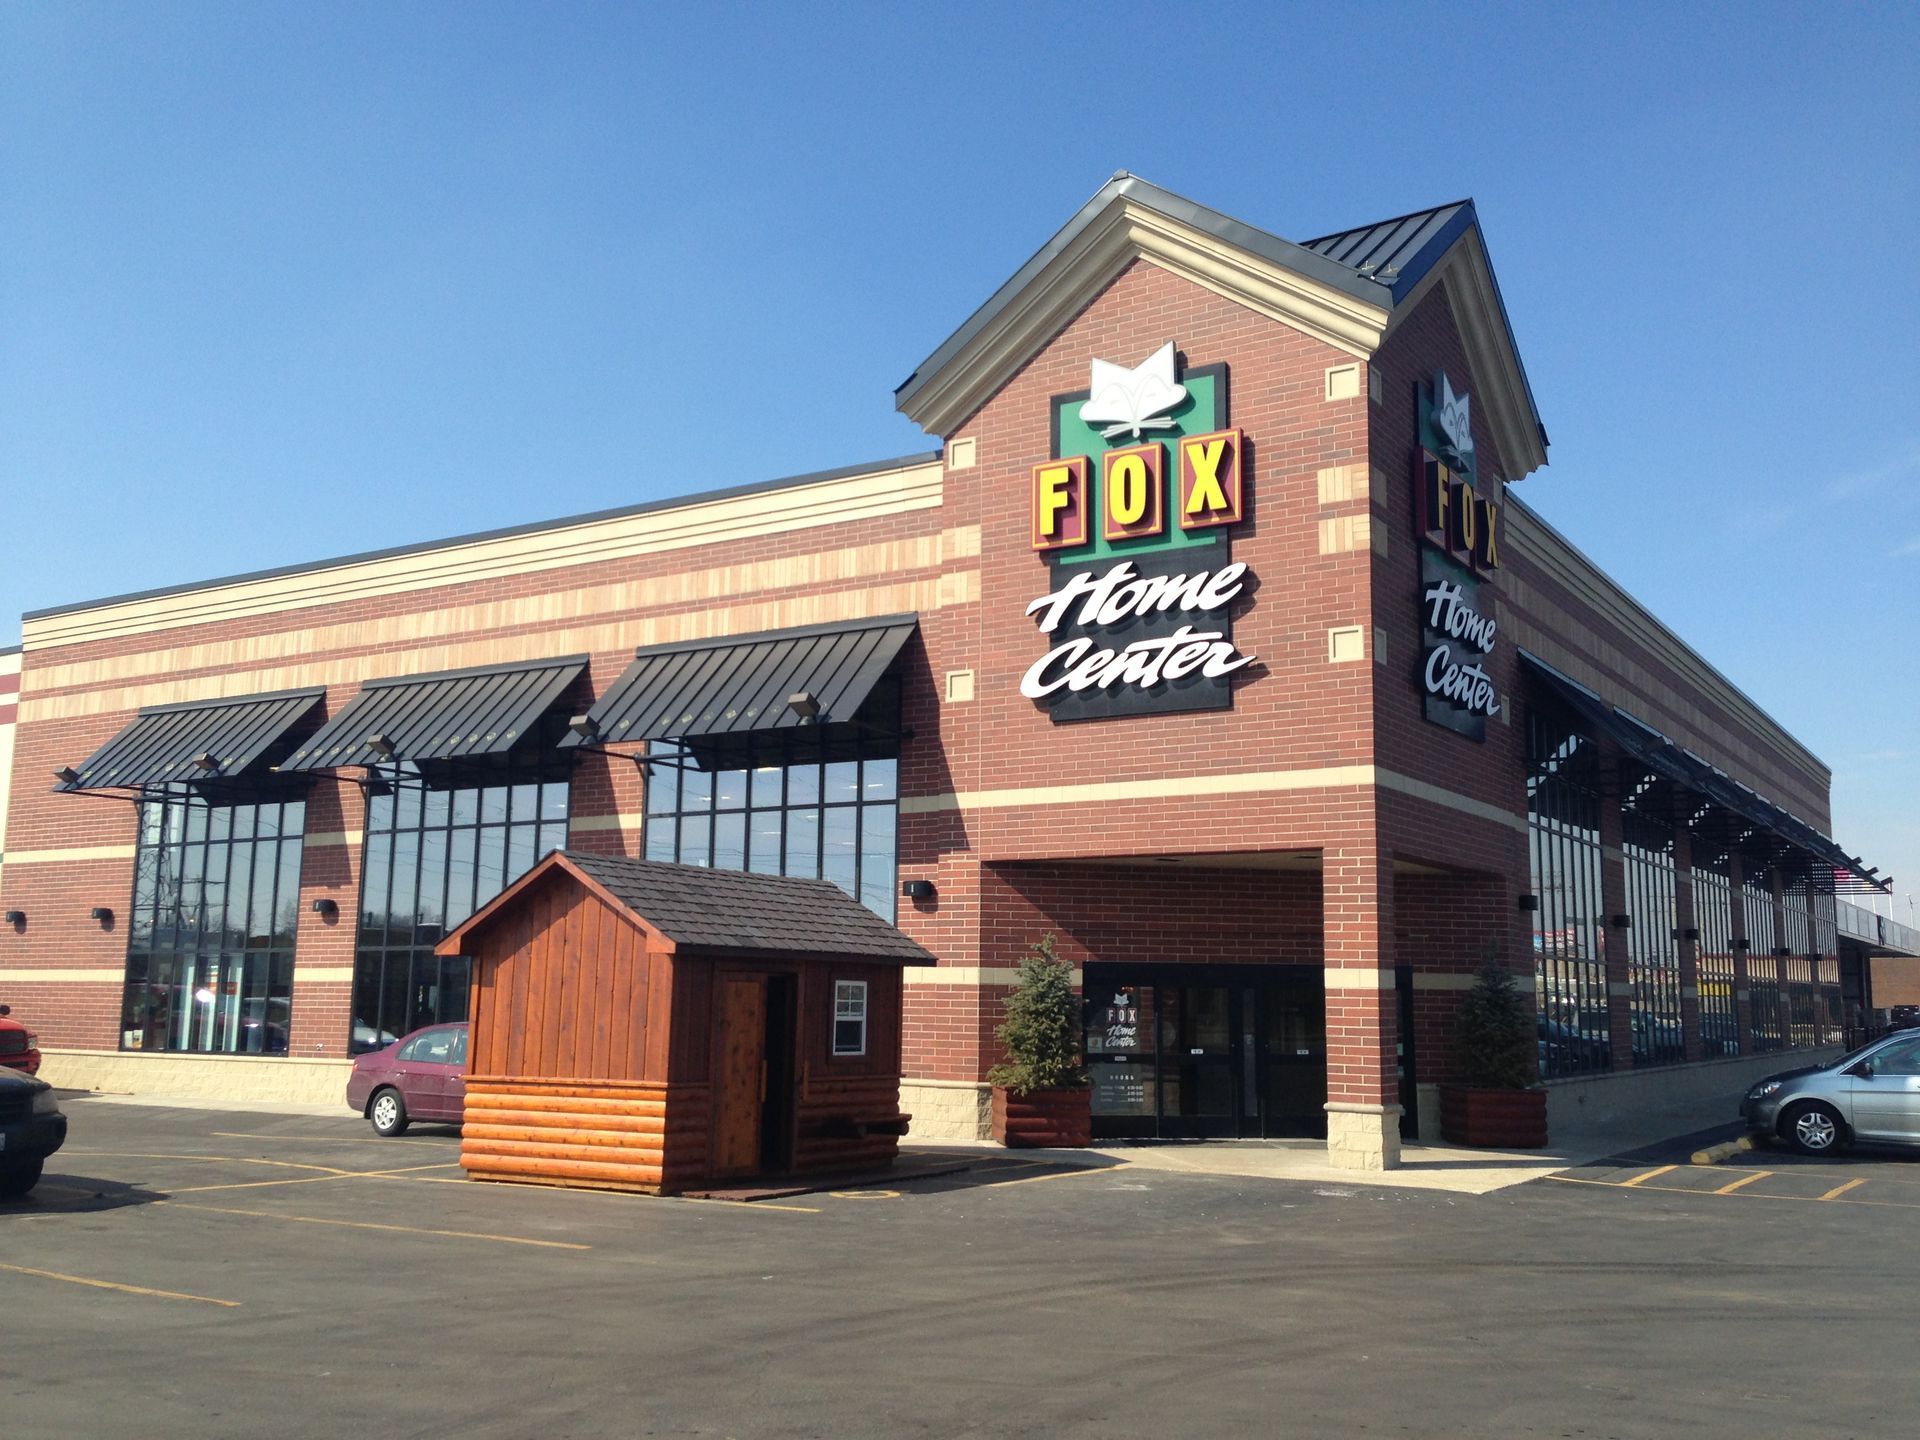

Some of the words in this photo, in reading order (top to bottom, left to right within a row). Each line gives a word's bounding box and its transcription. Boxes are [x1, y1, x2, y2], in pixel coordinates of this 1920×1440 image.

[1038, 439, 1228, 536] FOX
[1436, 468, 1499, 569] FOX
[1024, 561, 1248, 633] Home
[1425, 579, 1496, 654] Home
[1019, 625, 1258, 699] Center
[1424, 644, 1500, 716] Center
[1105, 1036, 1136, 1047] Center
[1106, 1025, 1136, 1036] Home
[1108, 1009, 1136, 1021] FOX
